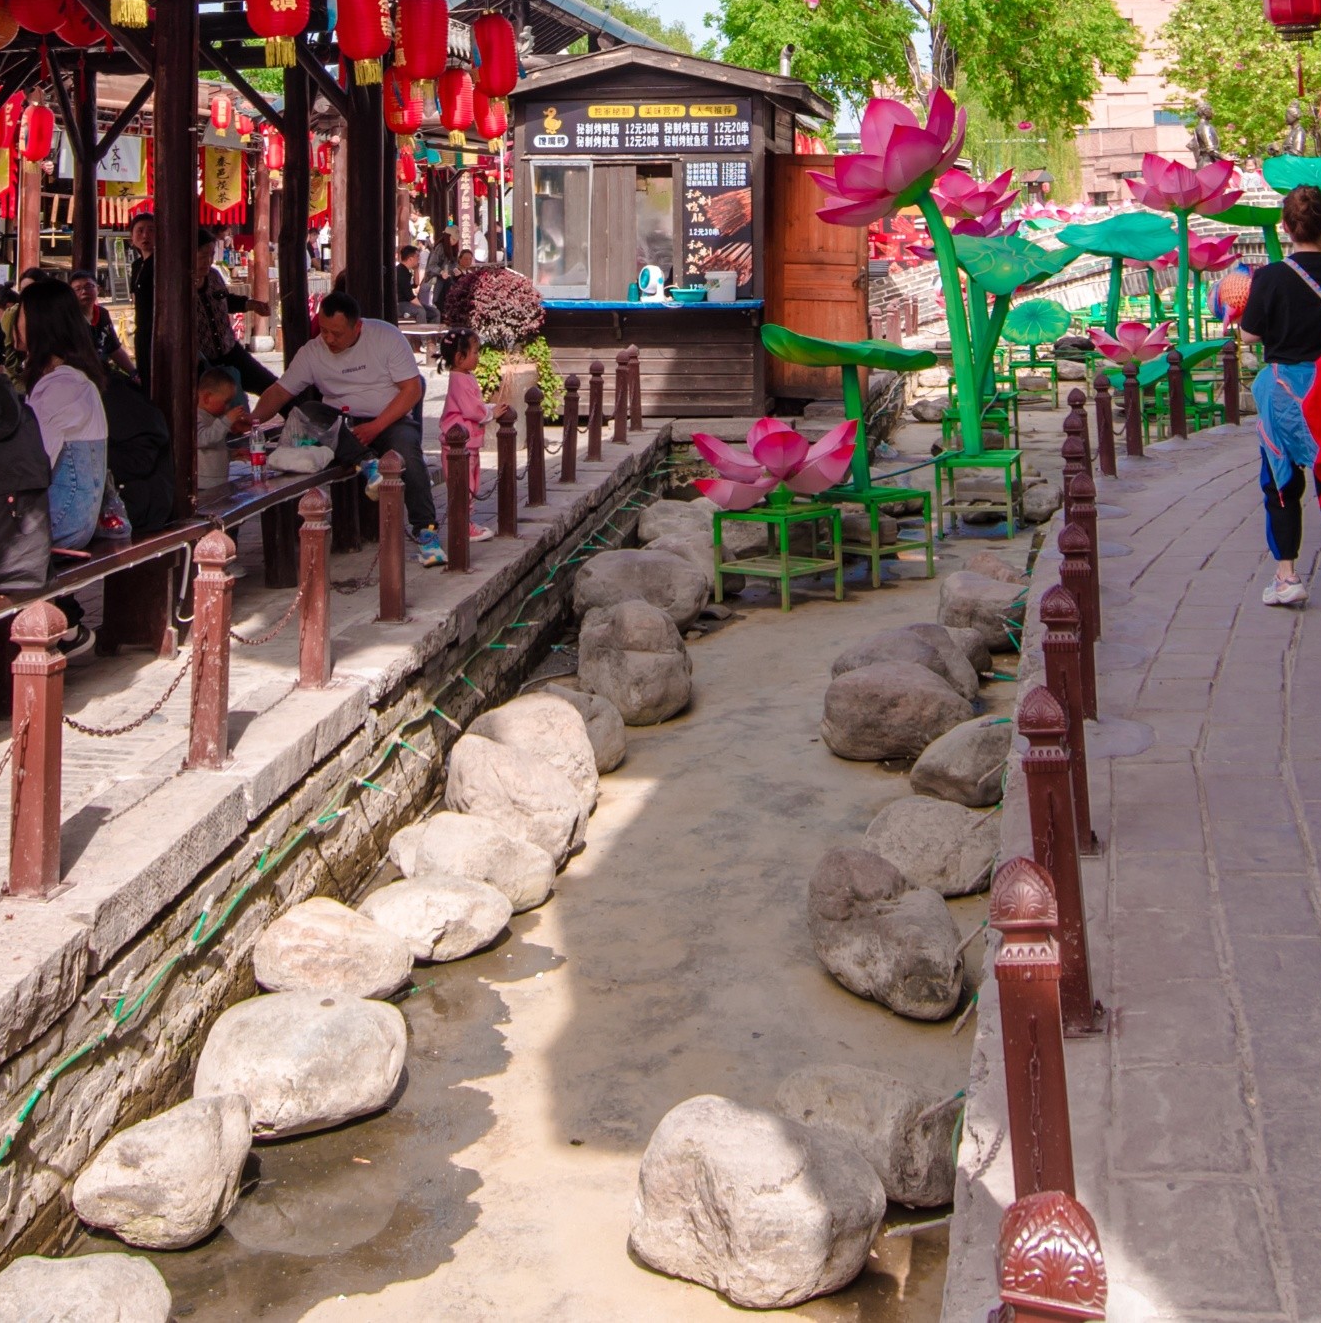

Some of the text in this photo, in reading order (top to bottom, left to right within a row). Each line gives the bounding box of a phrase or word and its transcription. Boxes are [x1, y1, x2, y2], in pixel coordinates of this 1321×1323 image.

[625, 122, 660, 135] 12元30串
[664, 122, 709, 134] 秘制烤面筋
[714, 121, 750, 134] 12元20串
[625, 135, 660, 148] 12元20串
[714, 134, 750, 147] 12元10串
